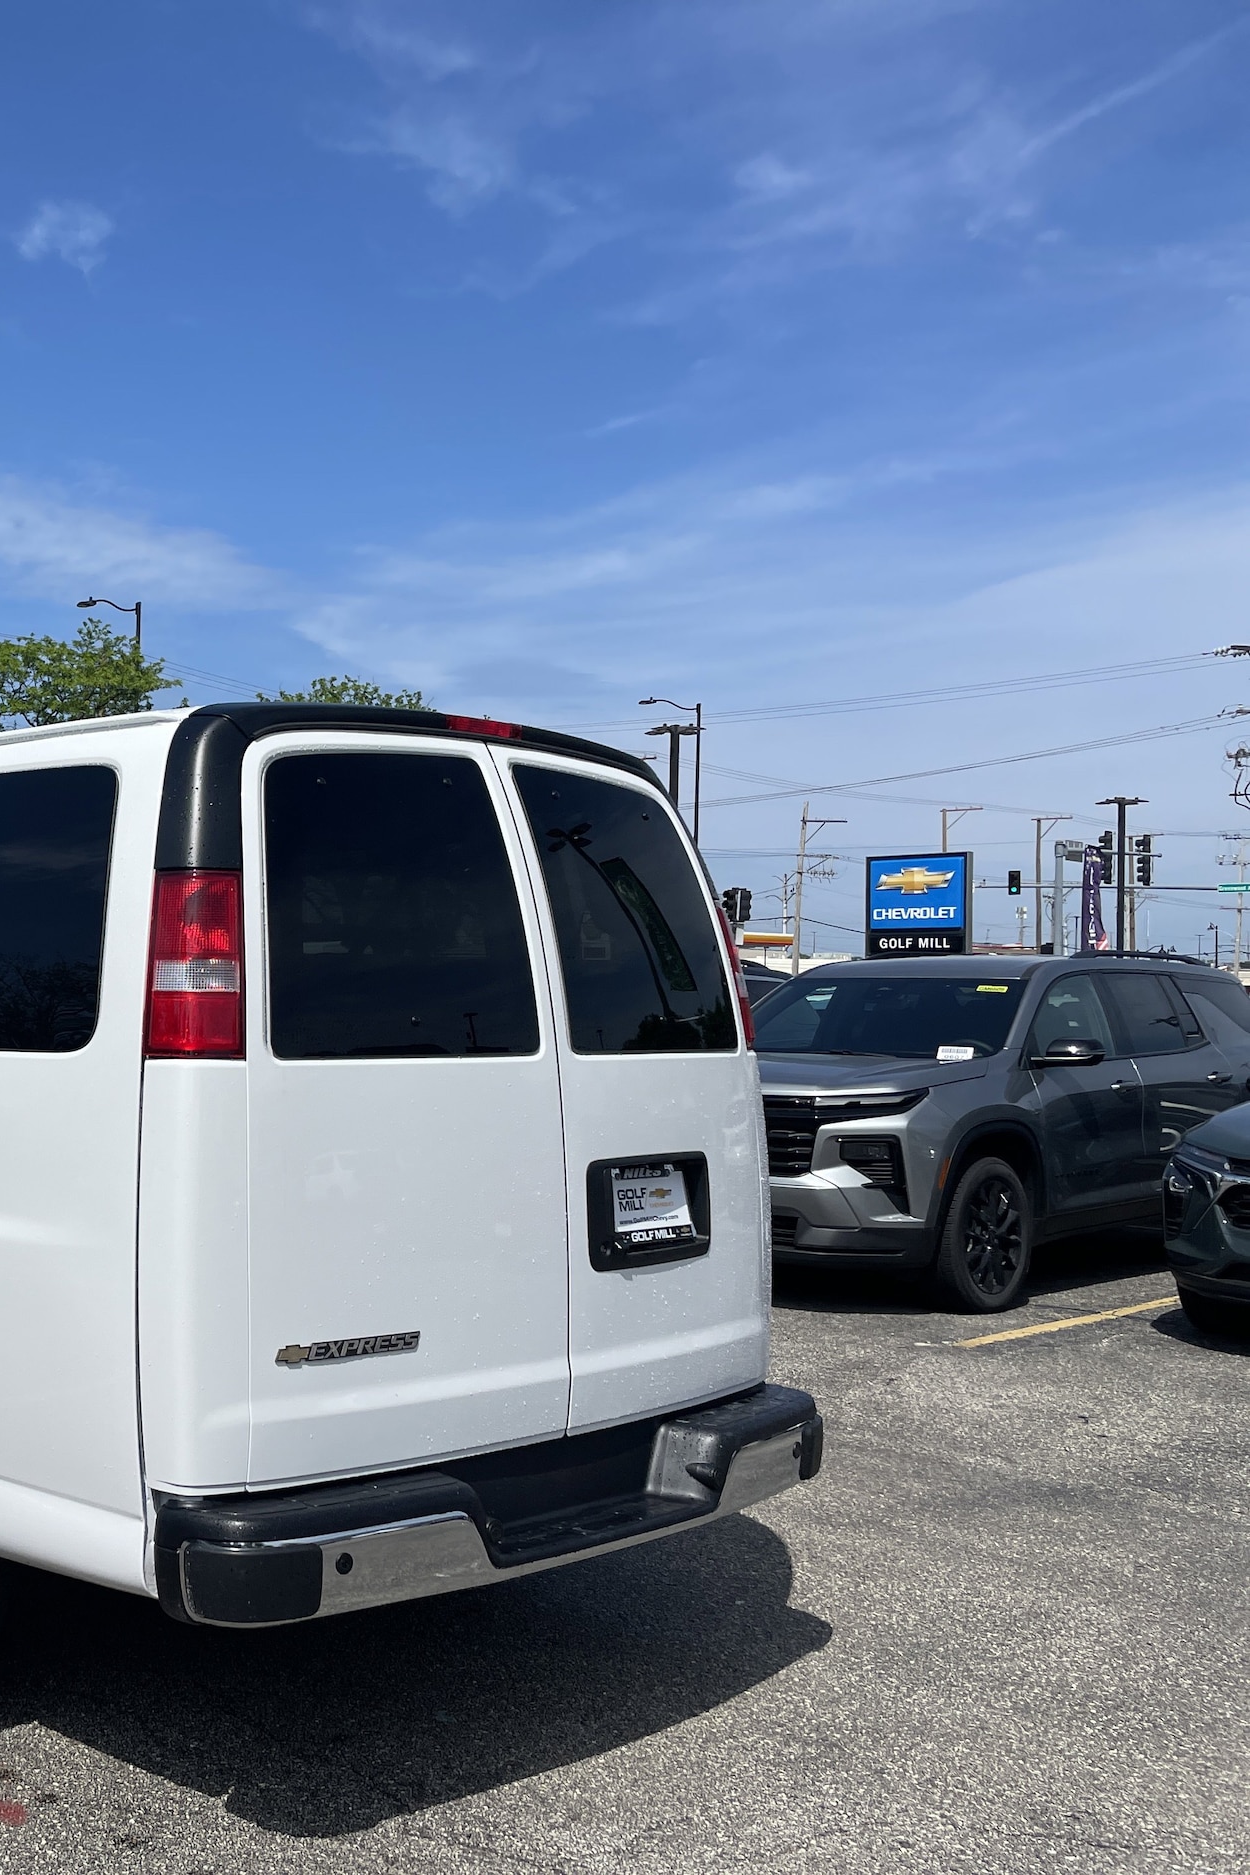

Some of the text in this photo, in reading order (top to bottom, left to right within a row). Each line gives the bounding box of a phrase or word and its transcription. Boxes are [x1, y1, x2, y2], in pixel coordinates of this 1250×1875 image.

[873, 907, 957, 920] CHEVROLET
[879, 938, 950, 949] GOLF MILL
[623, 1167, 661, 1179] NILES
[617, 1188, 646, 1200] GOLF
[619, 1200, 644, 1212] MILL
[308, 1332, 420, 1361] EXPRESS
